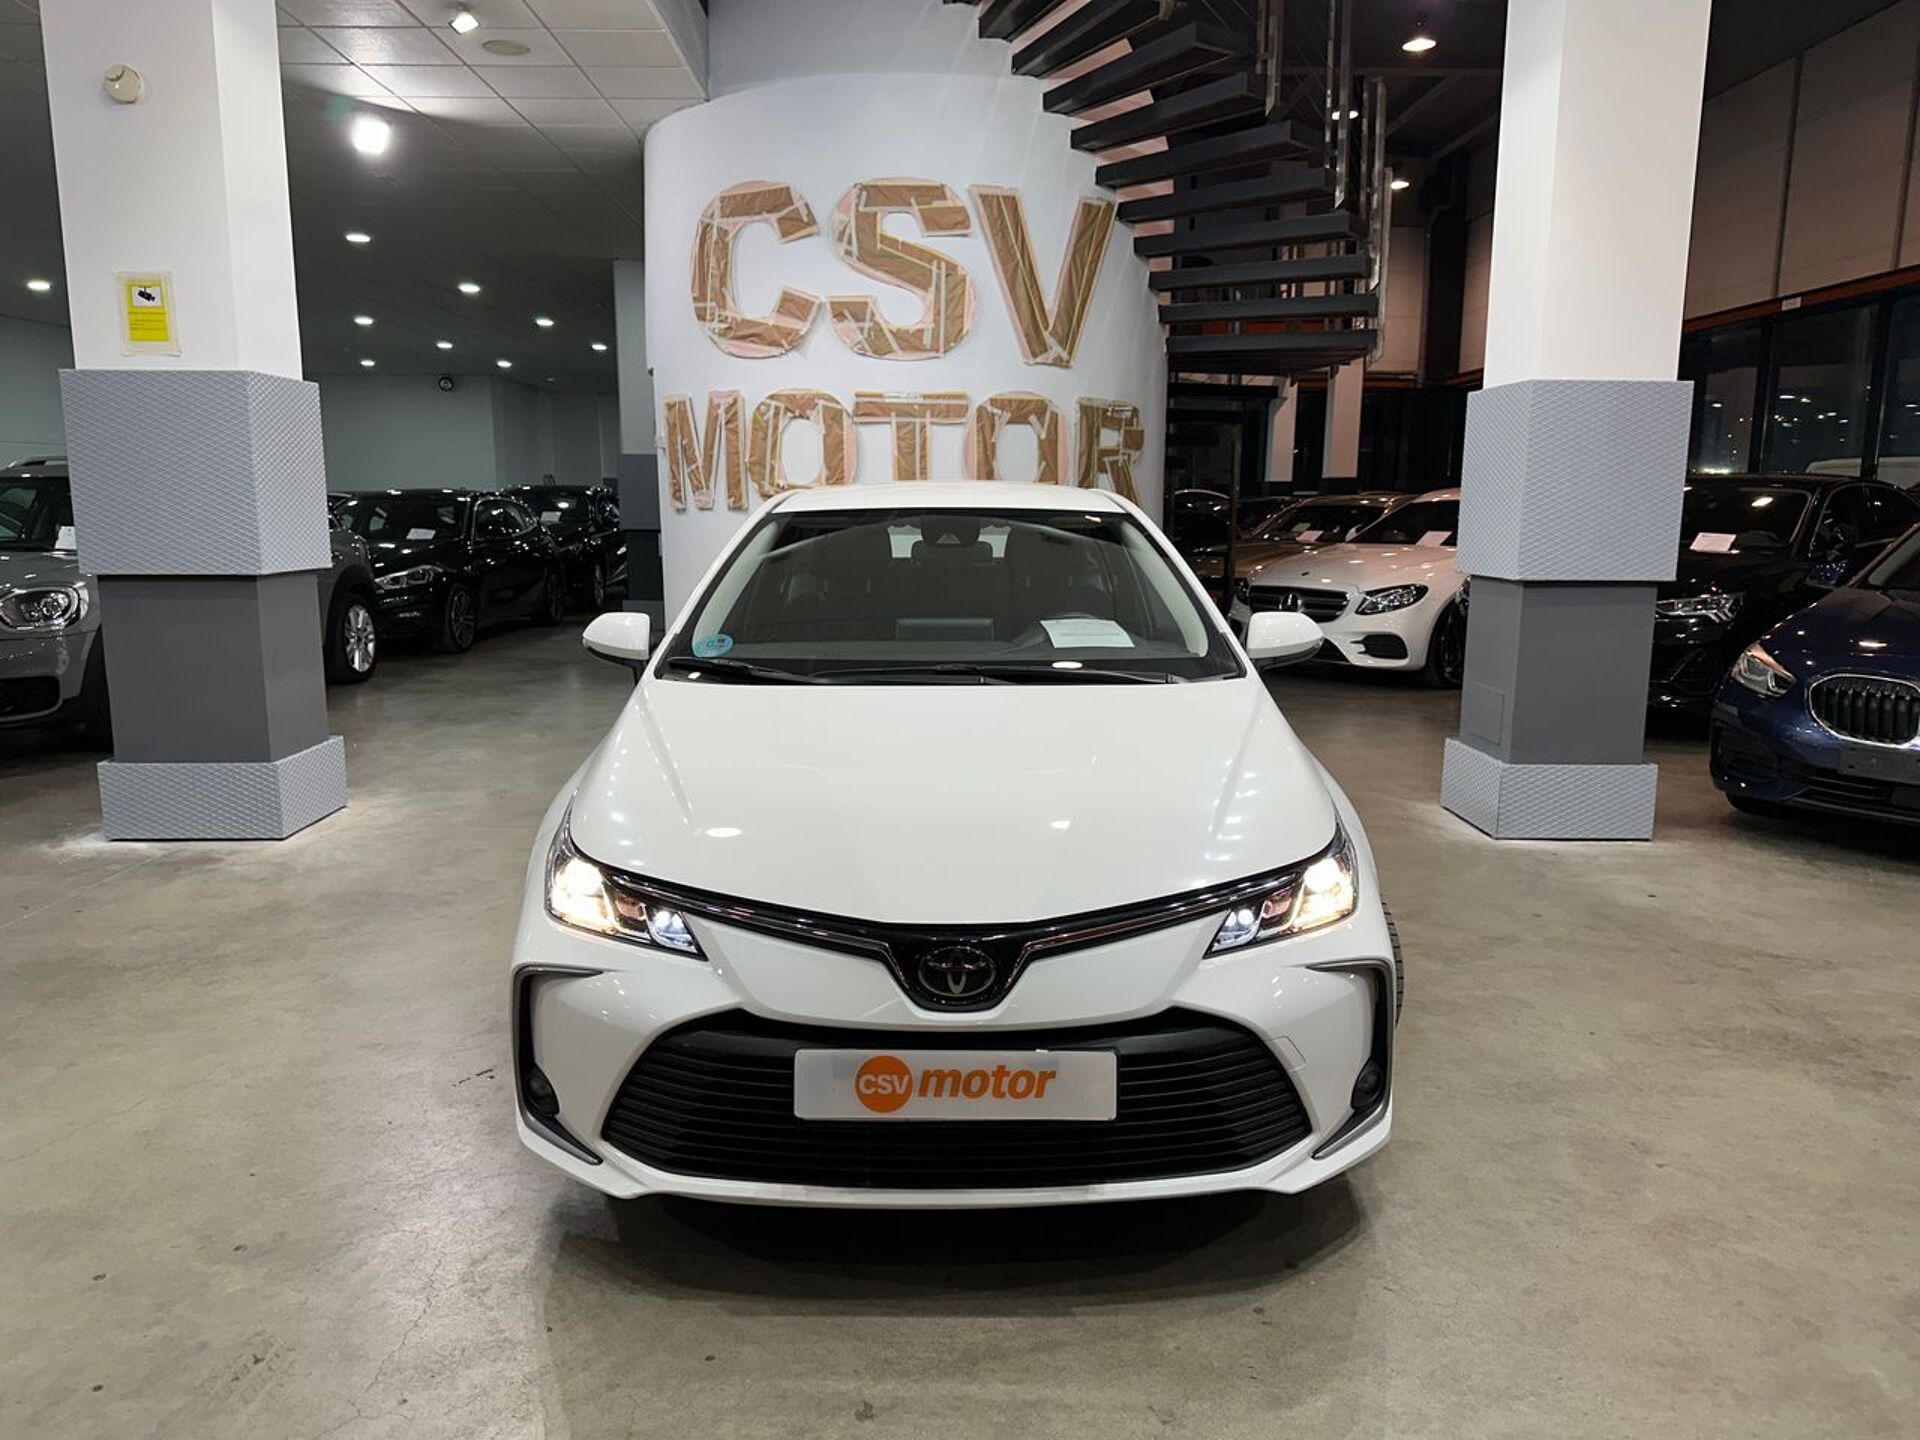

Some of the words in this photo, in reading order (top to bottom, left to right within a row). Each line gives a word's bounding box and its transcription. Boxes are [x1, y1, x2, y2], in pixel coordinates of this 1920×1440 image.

[691, 178, 1118, 367] CSV
[664, 389, 1145, 510] MOTOR
[918, 1065, 1057, 1099] motor
